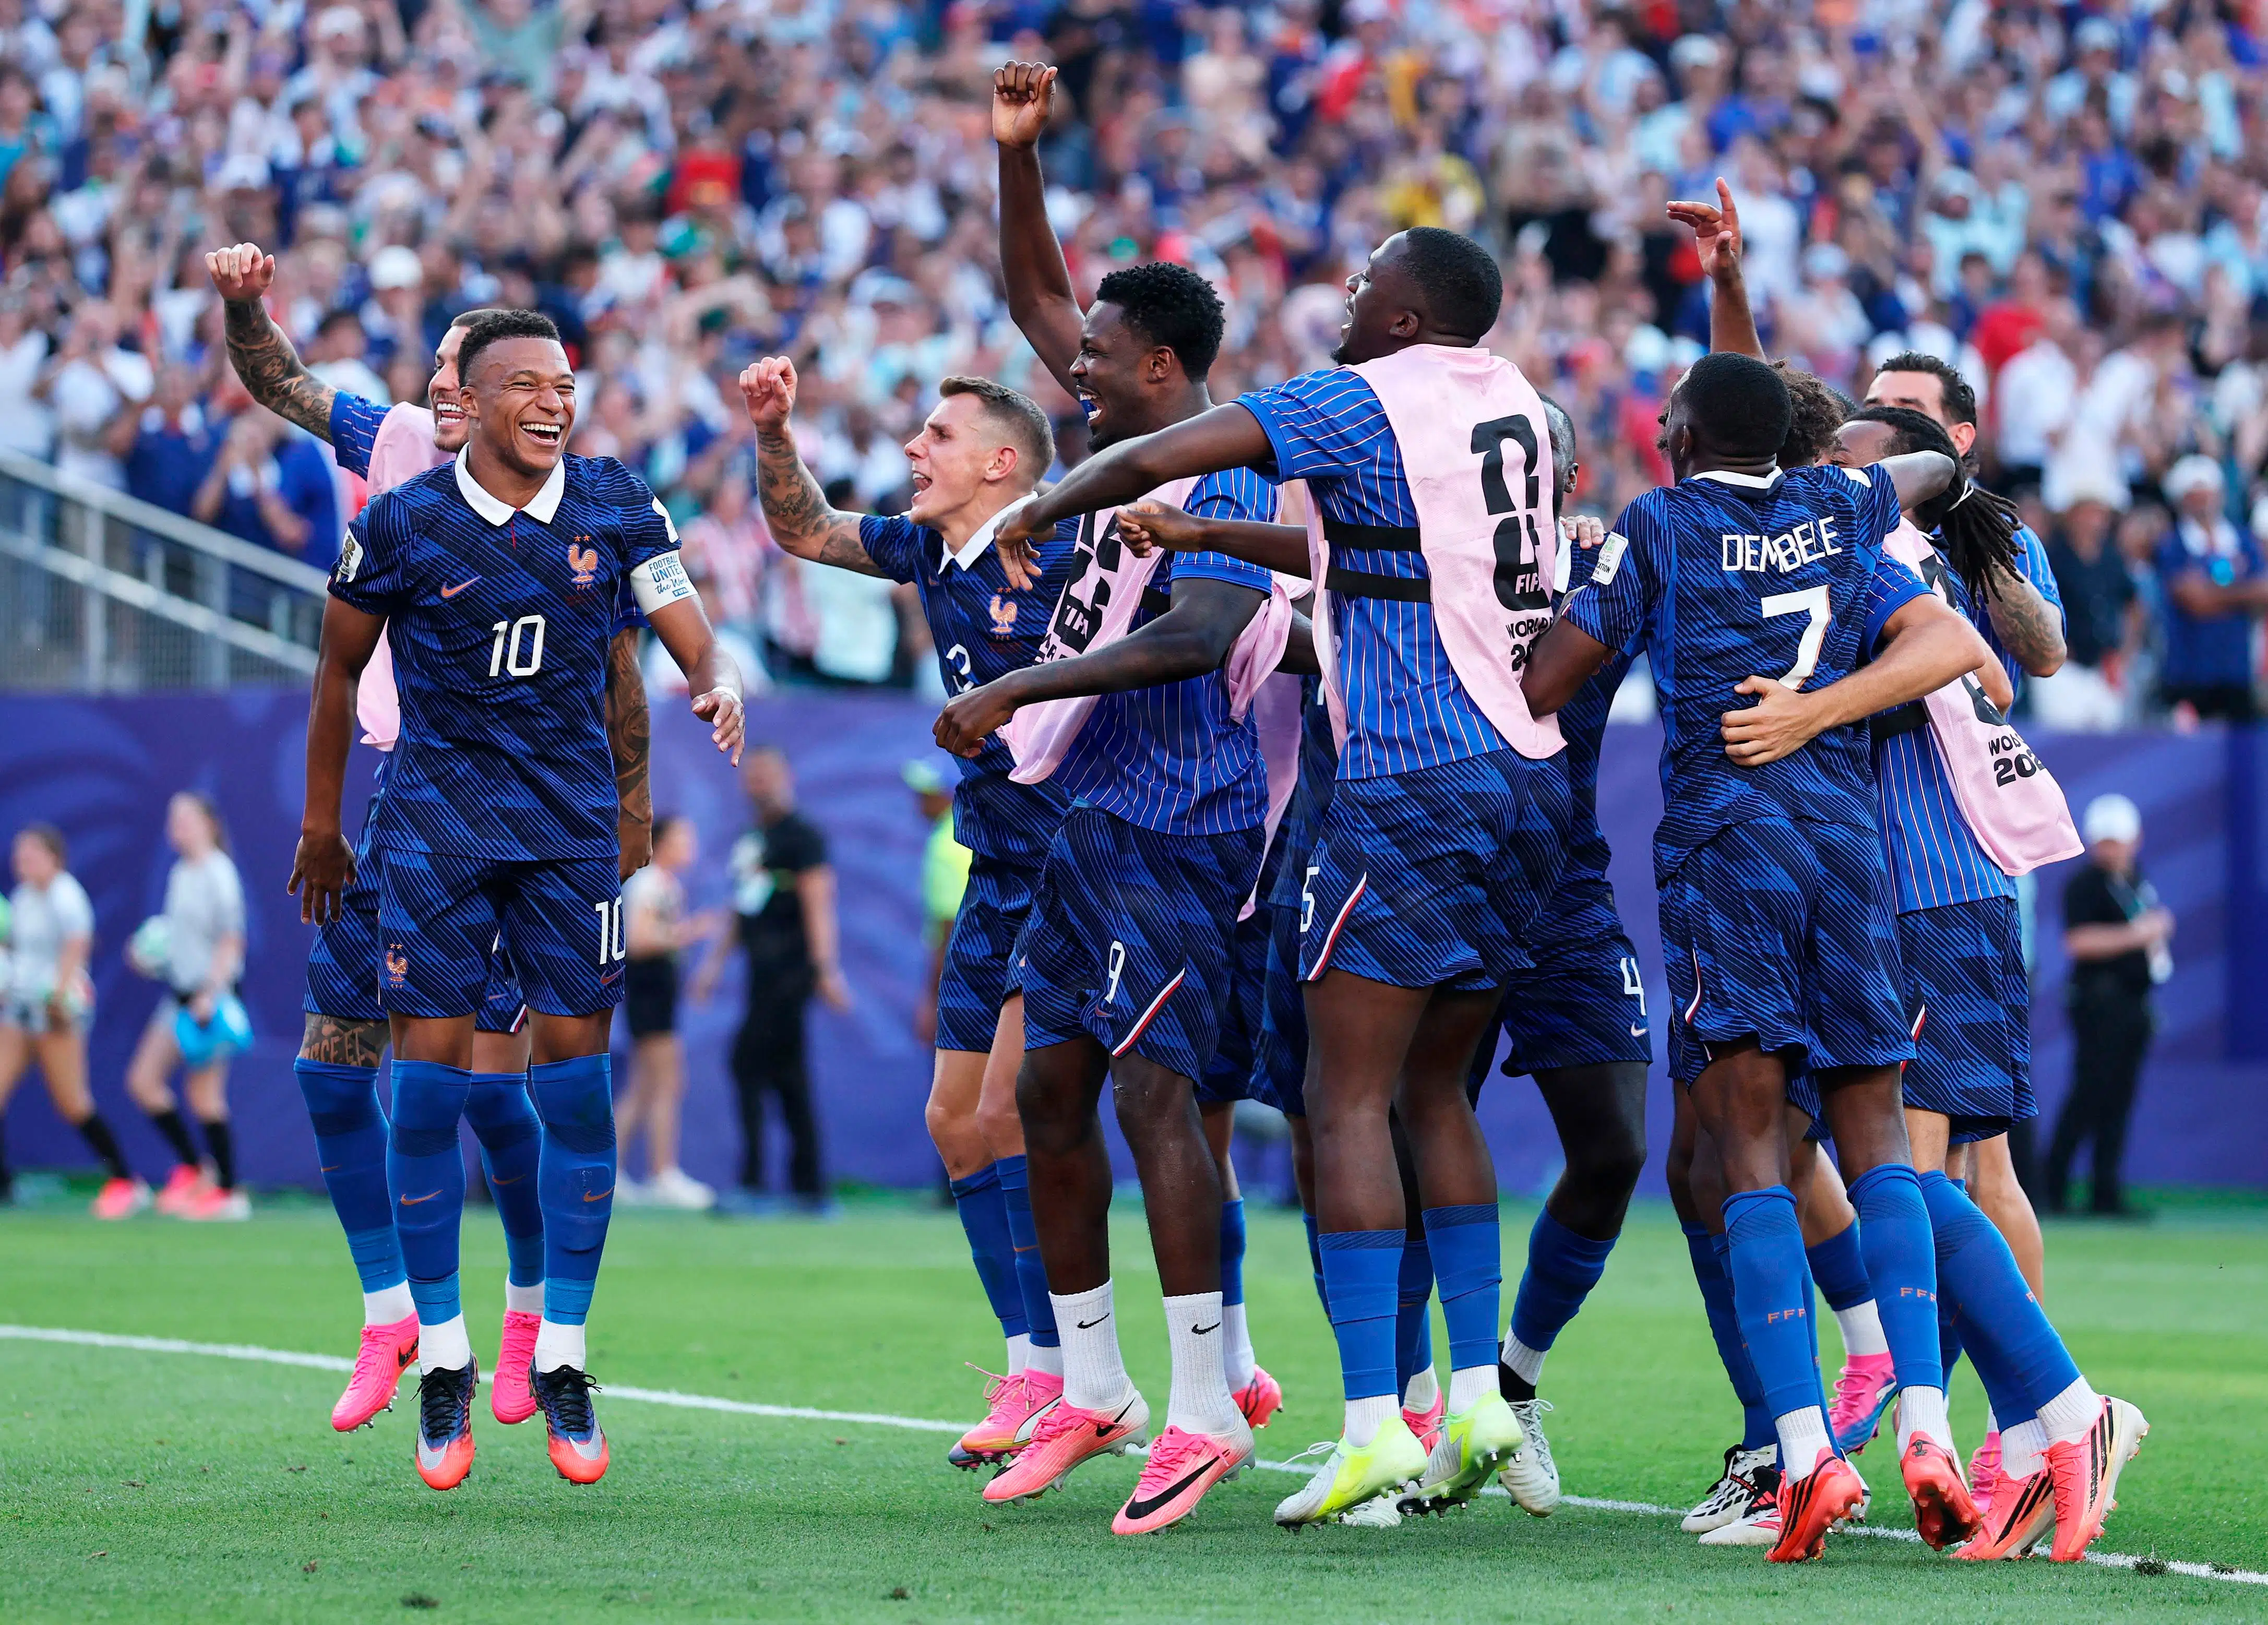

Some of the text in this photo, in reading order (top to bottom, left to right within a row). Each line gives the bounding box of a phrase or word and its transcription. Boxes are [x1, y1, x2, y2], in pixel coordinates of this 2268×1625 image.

[649, 555, 678, 572] FOOTBALL
[652, 564, 683, 583] UNITES
[655, 583, 671, 594] the
[489, 614, 546, 677] 10
[1761, 583, 1832, 691] 7
[1300, 866, 1320, 933] 5
[595, 895, 626, 965] 10
[1104, 940, 1126, 1005] 9
[1620, 958, 1647, 1016] 4
[1768, 1308, 1806, 1324] FFF
